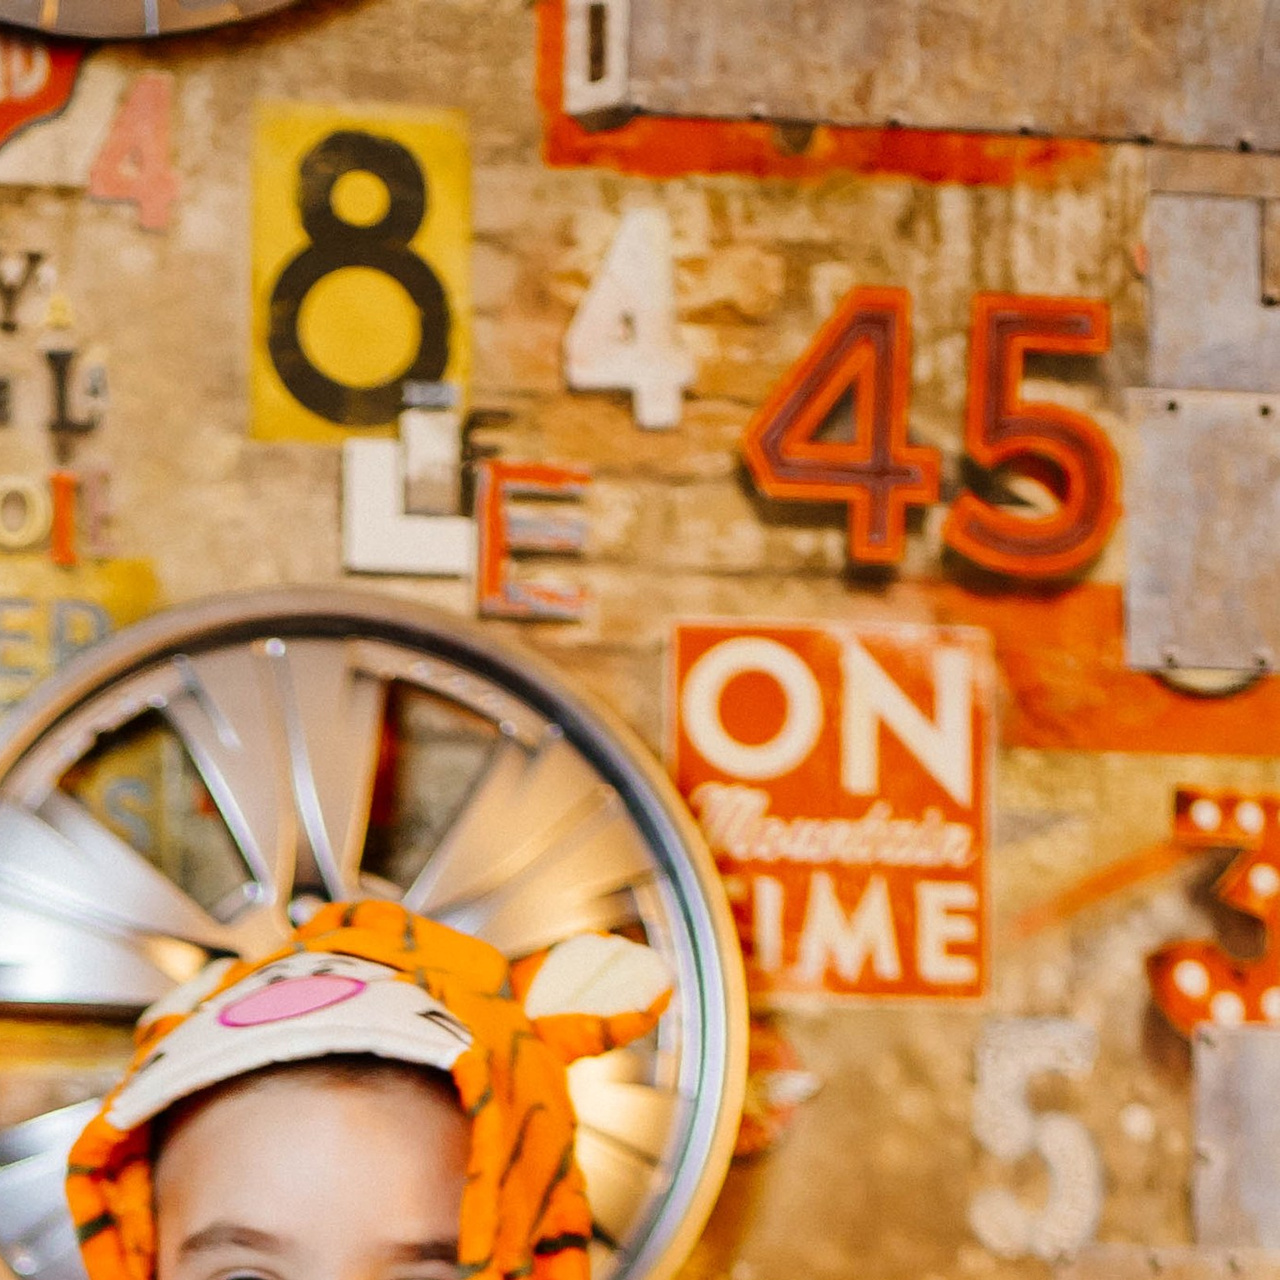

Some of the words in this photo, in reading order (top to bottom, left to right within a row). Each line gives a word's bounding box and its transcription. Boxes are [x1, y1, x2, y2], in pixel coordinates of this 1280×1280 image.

[88, 72, 180, 230] 4
[268, 130, 452, 428] 8
[565, 207, 698, 428] 4
[743, 286, 1122, 577] 45
[682, 637, 974, 805] ON
[725, 868, 979, 984] IME
[970, 1015, 1103, 1258] 5
